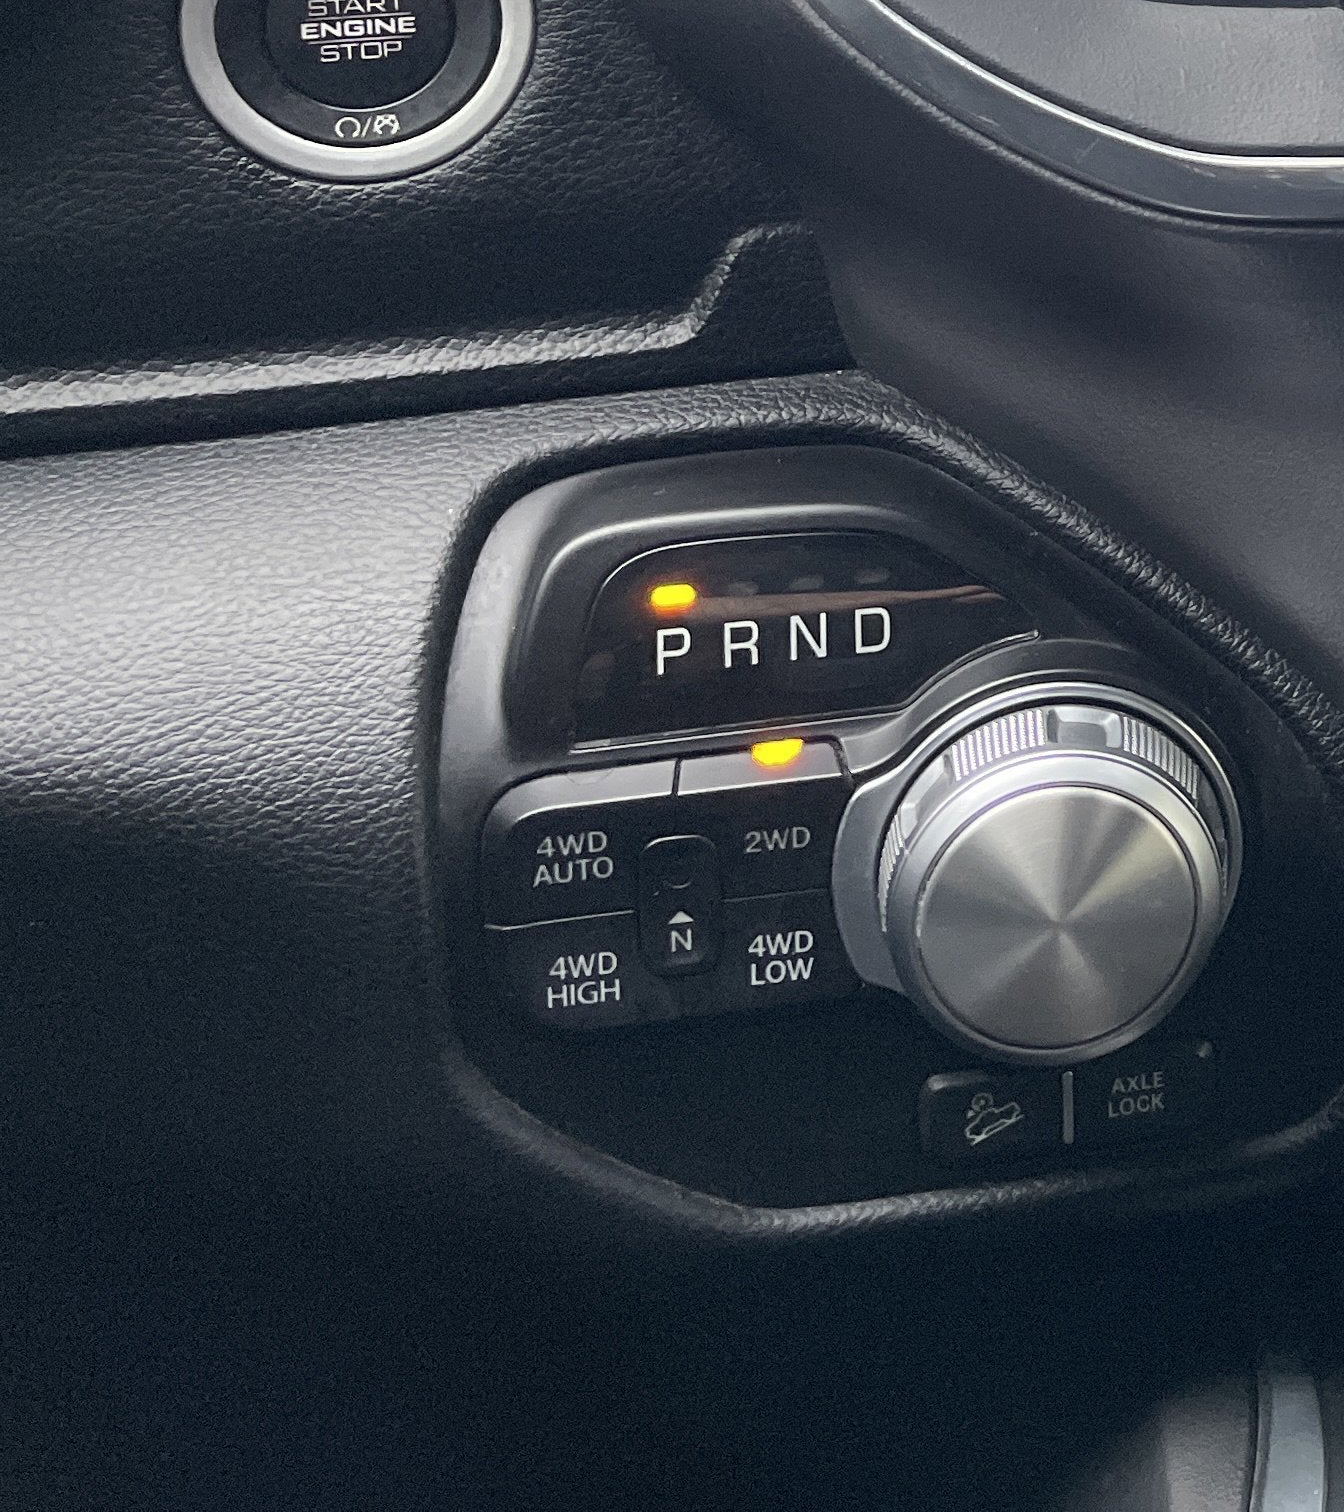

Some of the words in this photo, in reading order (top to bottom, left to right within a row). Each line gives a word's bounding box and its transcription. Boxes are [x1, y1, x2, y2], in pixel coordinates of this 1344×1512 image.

[300, 16, 417, 41] ENGINE
[319, 40, 403, 63] STOP
[655, 626, 692, 676] P
[723, 619, 761, 668] R
[789, 612, 828, 661] N
[854, 606, 893, 655] D
[536, 831, 608, 861] 4WD
[744, 826, 812, 854] 2WD
[532, 855, 615, 888] AUTO
[670, 927, 693, 953] N
[747, 929, 815, 959] 4WD
[548, 951, 619, 981] 4WD
[749, 956, 815, 987] LOW
[546, 979, 622, 1009] HIGH
[1112, 1069, 1166, 1097] AXLE
[1107, 1092, 1166, 1119] LOCK
